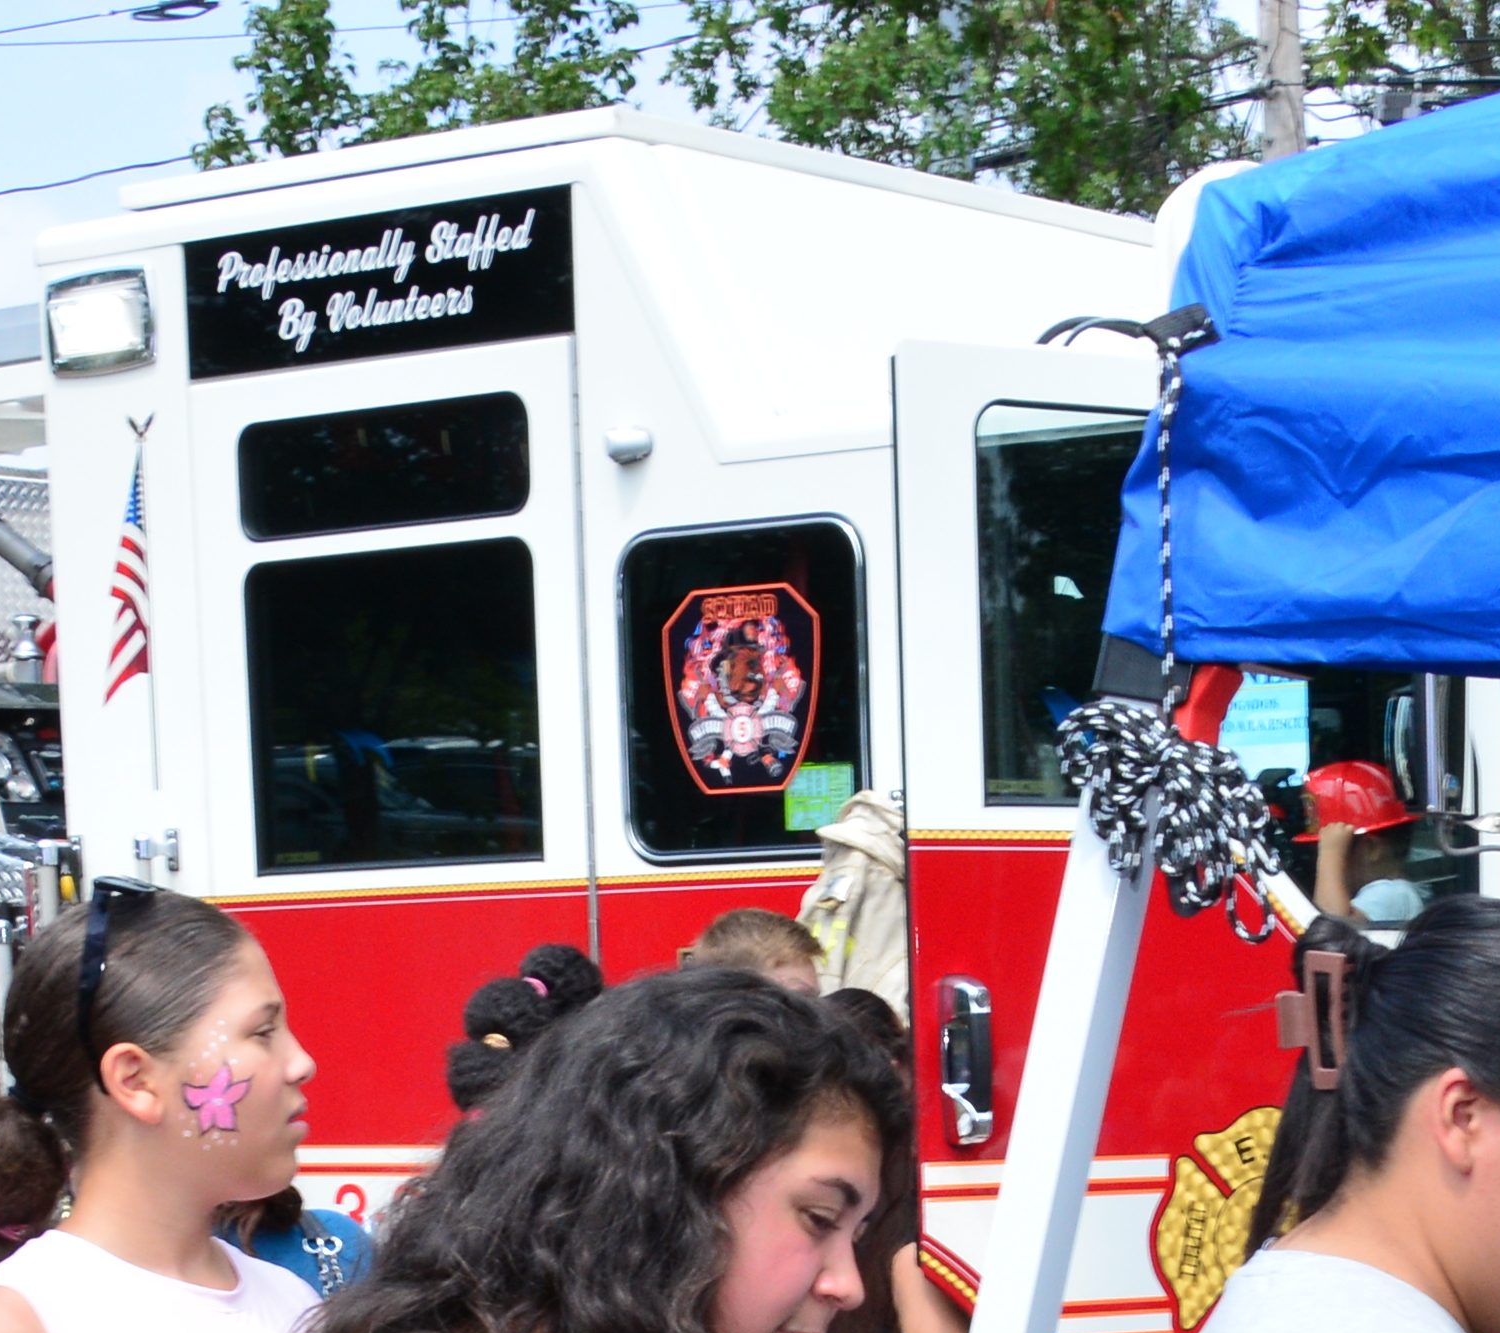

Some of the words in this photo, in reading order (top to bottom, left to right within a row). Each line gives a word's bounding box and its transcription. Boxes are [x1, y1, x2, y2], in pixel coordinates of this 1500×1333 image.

[217, 227, 416, 301] Professionally
[425, 208, 536, 272] Staffed
[277, 298, 317, 353] By
[326, 285, 474, 333] Volunteers
